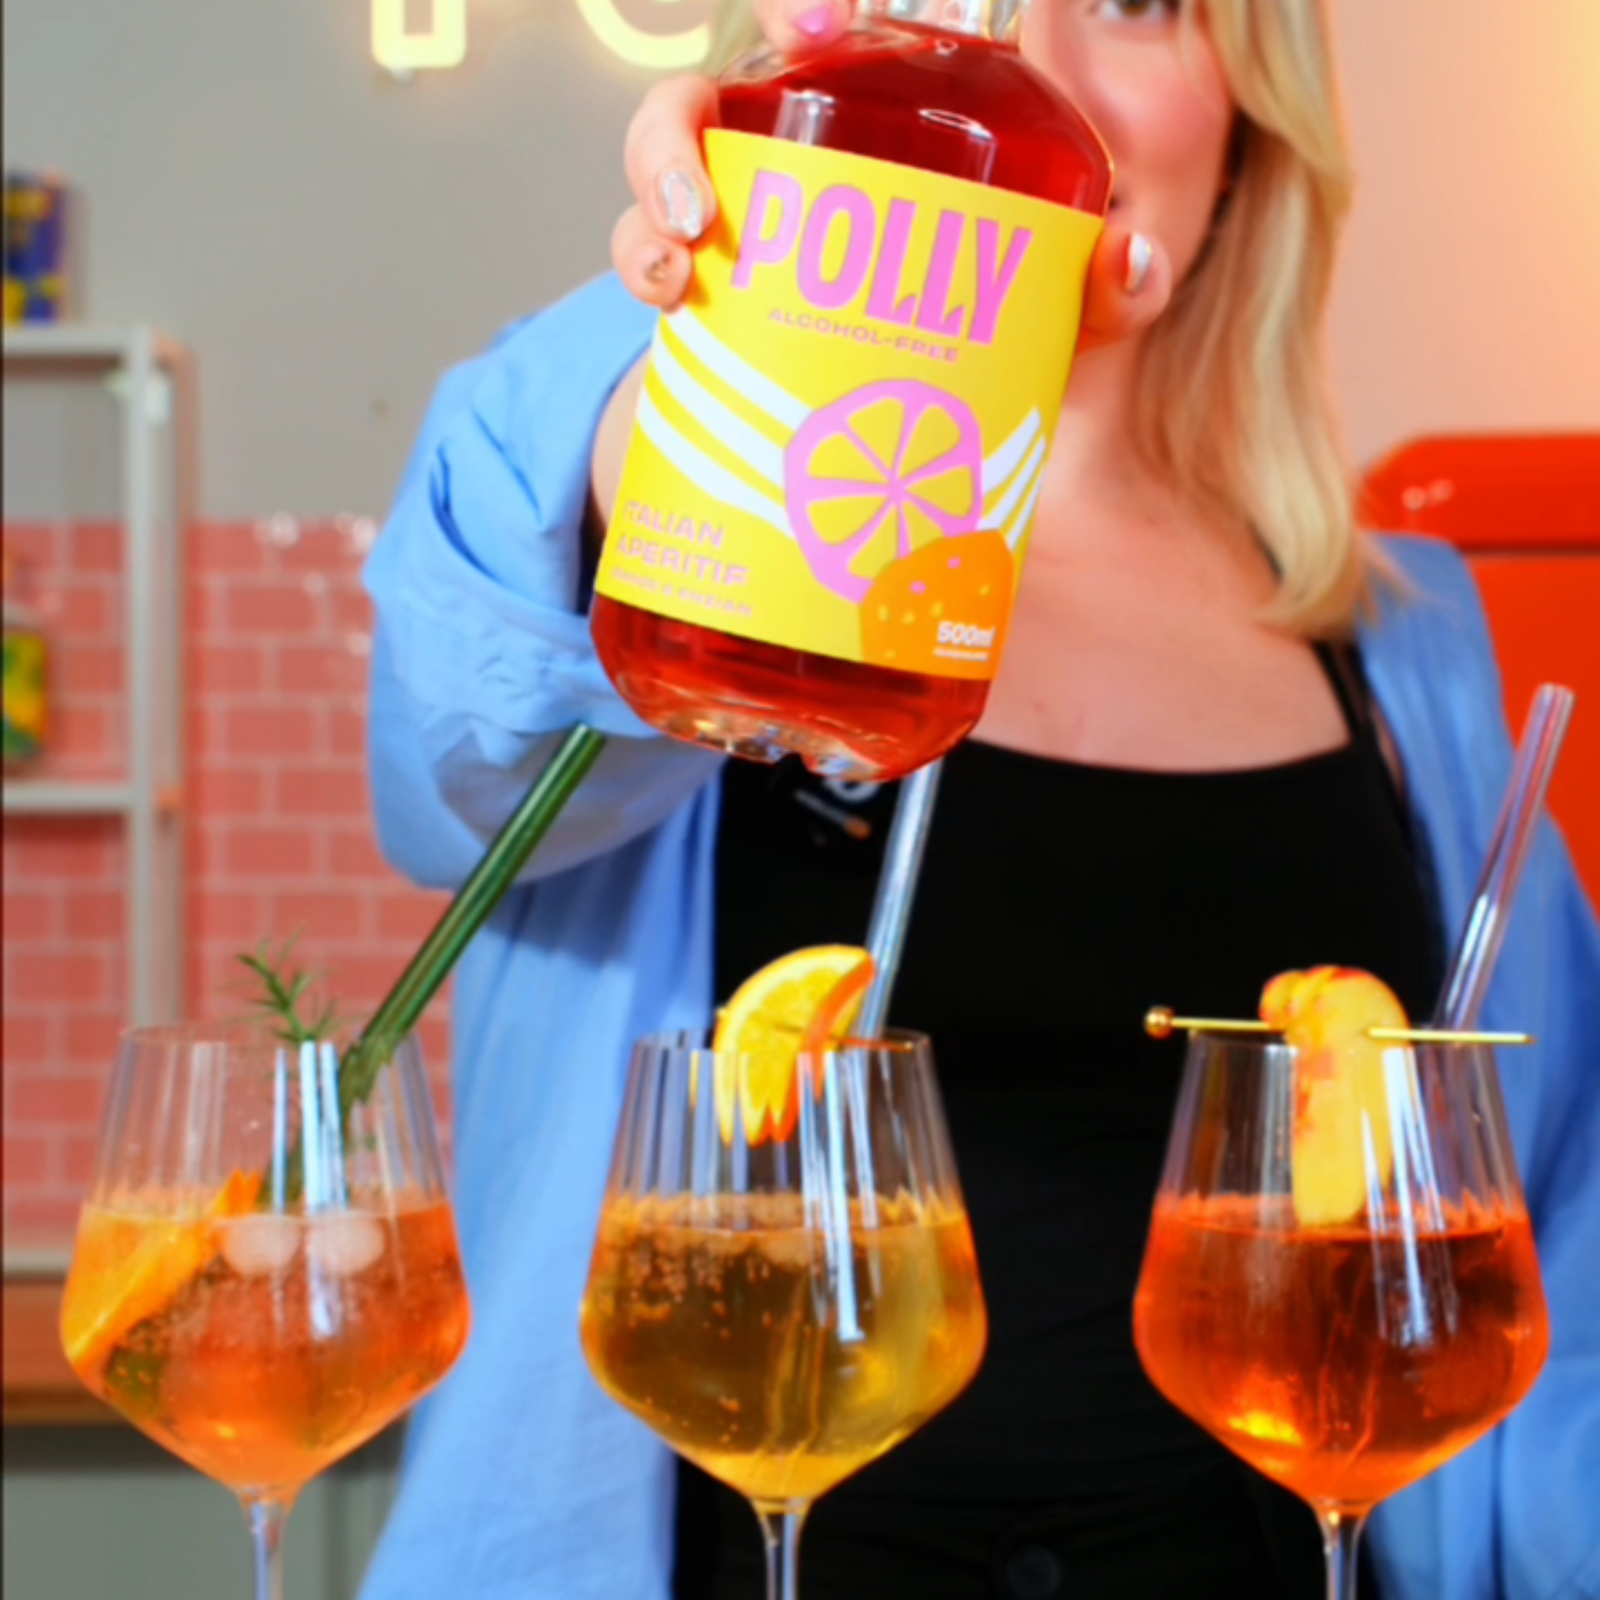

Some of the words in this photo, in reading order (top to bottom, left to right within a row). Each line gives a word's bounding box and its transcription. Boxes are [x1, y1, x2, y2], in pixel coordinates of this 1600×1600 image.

[731, 167, 1034, 346] POLLY
[767, 308, 961, 364] ALCOHOL-FREE
[624, 501, 725, 549] ITALIAN
[617, 533, 750, 586] APERITIF
